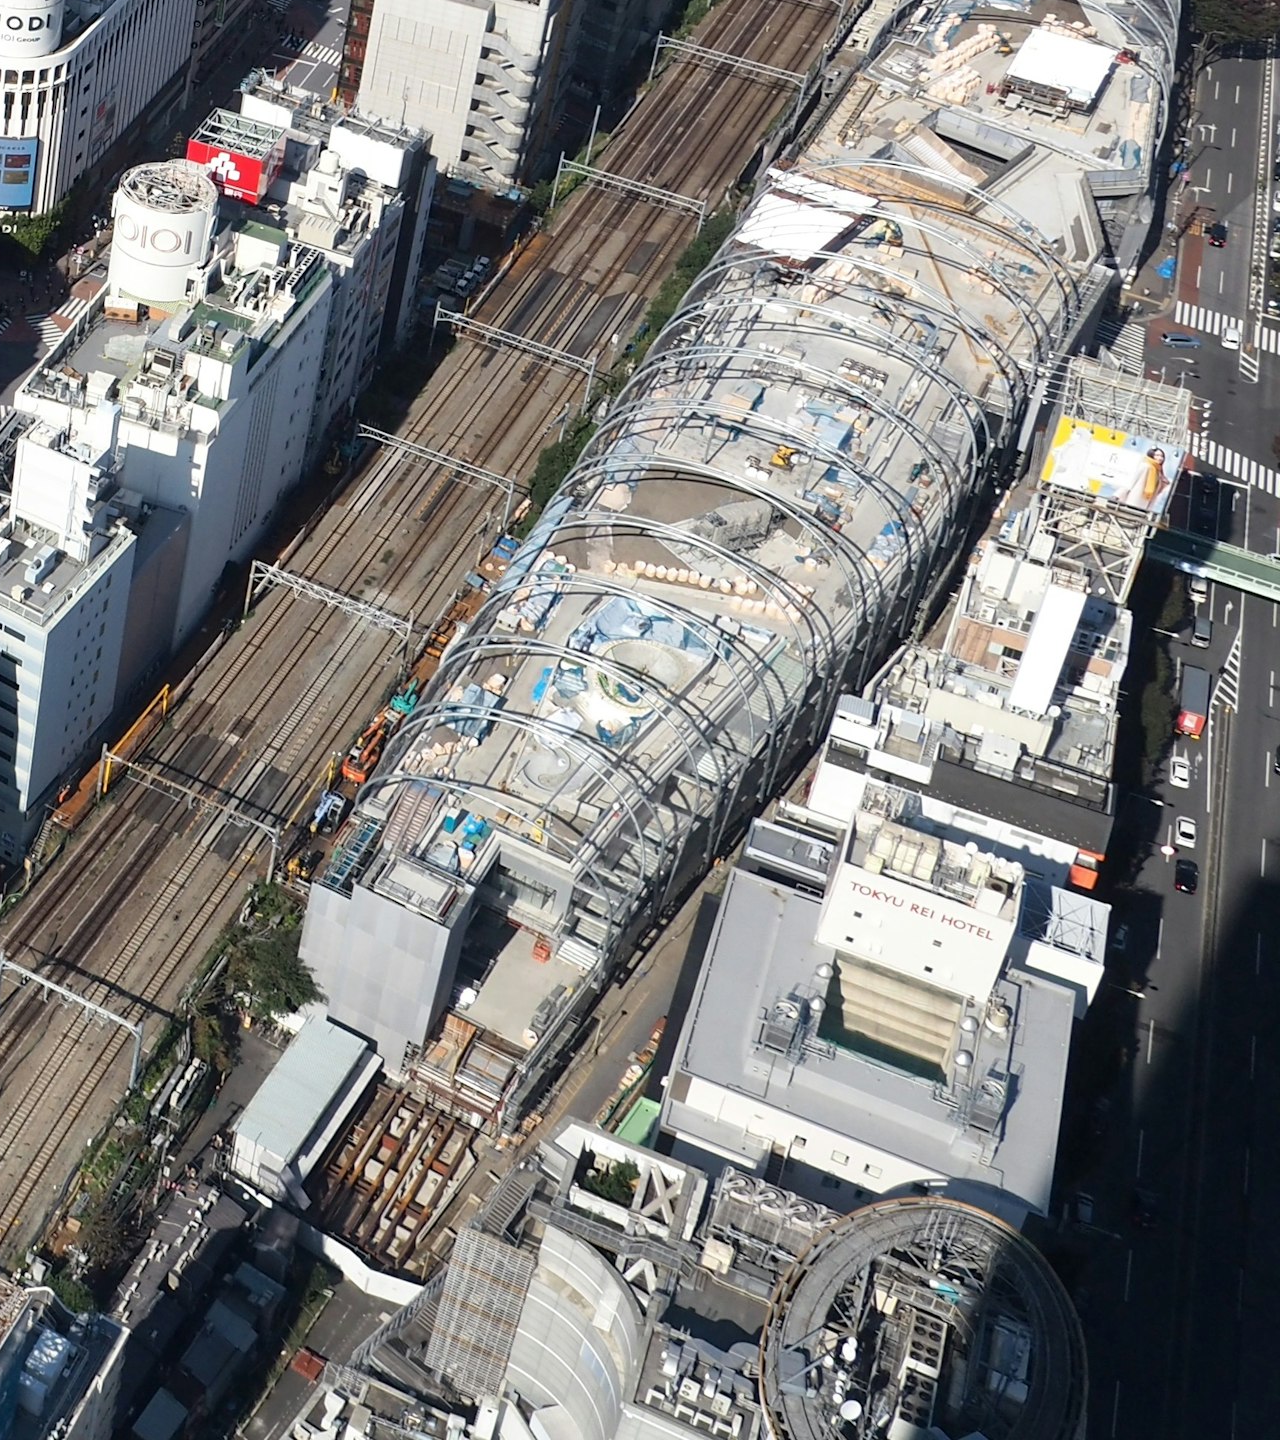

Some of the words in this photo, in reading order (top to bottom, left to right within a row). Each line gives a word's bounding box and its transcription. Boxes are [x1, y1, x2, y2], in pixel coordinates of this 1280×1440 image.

[851, 881, 905, 908] TOKYU
[910, 903, 936, 920] REI
[941, 914, 994, 941] HOTEL
